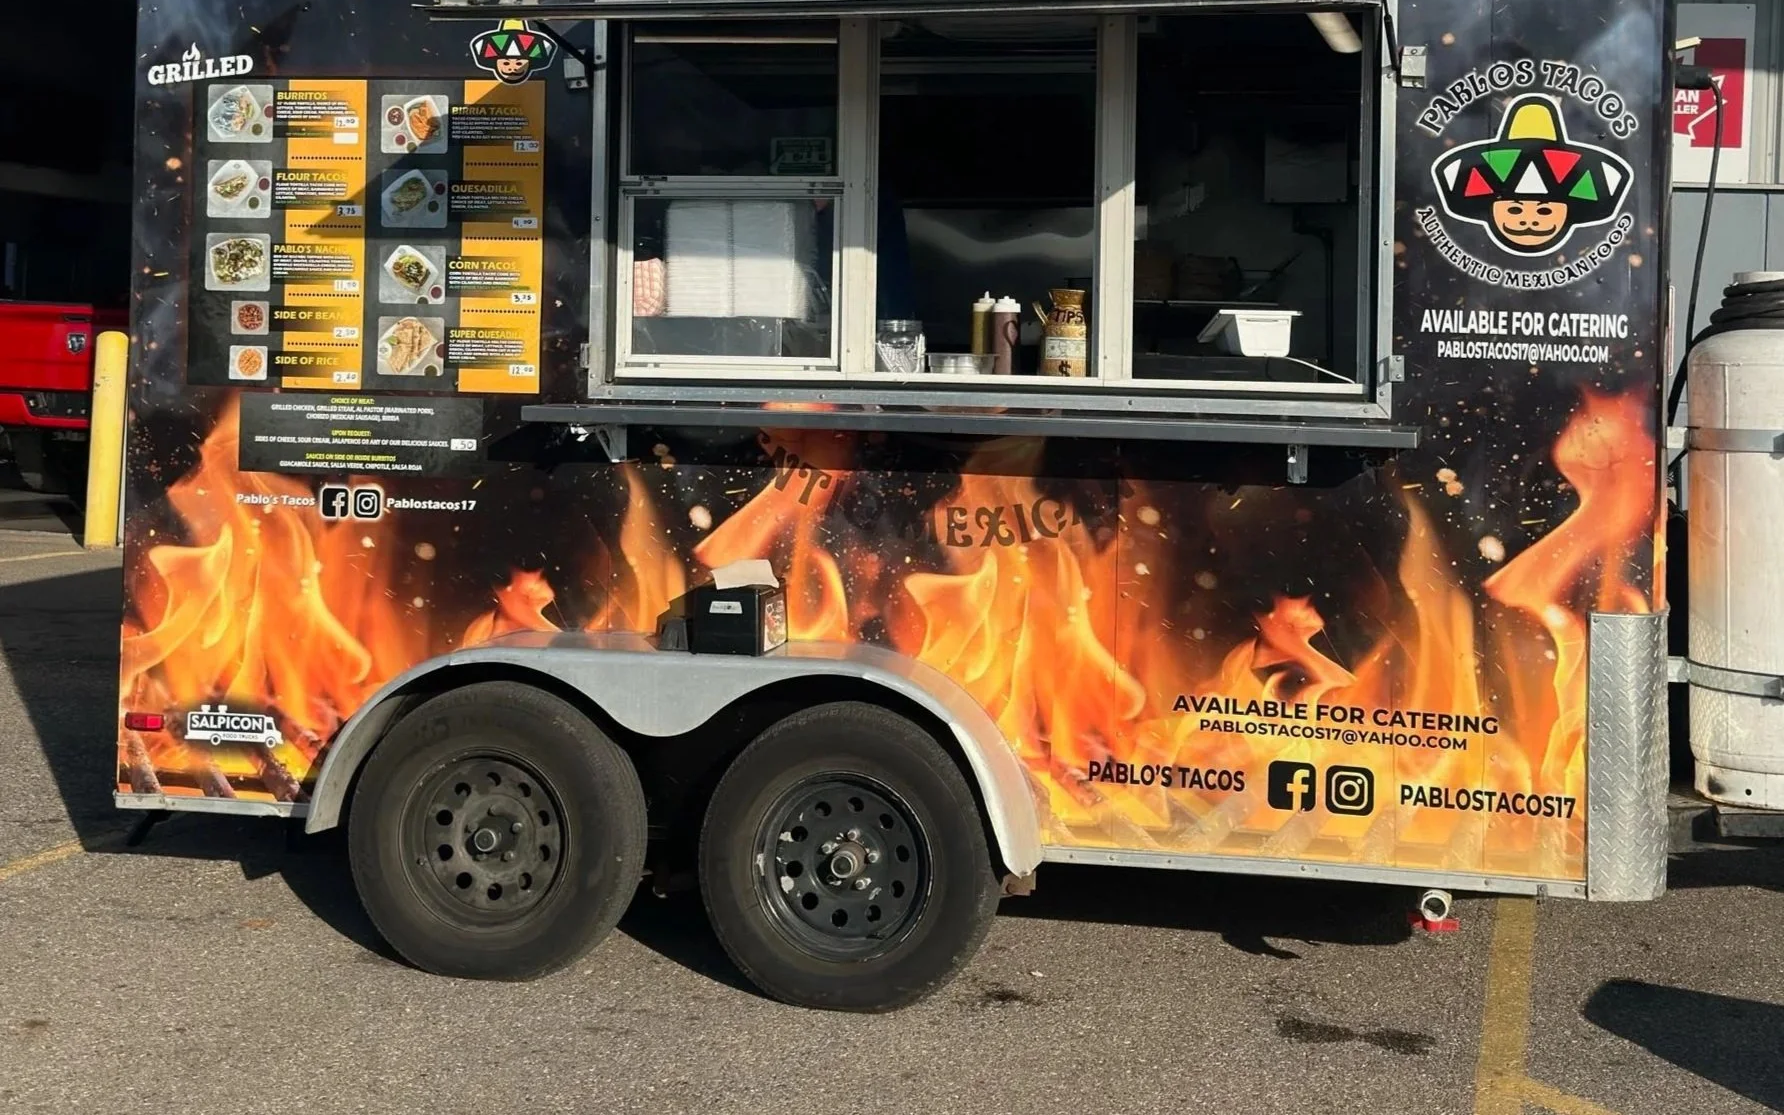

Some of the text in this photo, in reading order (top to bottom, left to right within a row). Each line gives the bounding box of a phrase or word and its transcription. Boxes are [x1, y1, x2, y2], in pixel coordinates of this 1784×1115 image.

[147, 55, 254, 85] GRILLED
[276, 92, 328, 101] BURRITOS
[1417, 59, 1639, 140] PABLOS TACOS
[452, 106, 488, 115] BIRRIA
[276, 172, 348, 182] FLOUR TACOS
[451, 184, 518, 194] QUESADILLA
[273, 244, 312, 254] PABLO'S
[1416, 205, 1502, 284] AUTHENTIC
[1503, 258, 1591, 289] MEXICAN
[448, 260, 517, 270] CORN TACOS
[274, 310, 297, 320] SIDE
[298, 311, 314, 320] OF
[1055, 309, 1083, 324] TIPS
[1420, 309, 1629, 339] AVAILABLE FOR CATERING
[449, 330, 477, 339] SUPER
[1437, 340, 1609, 365] PABLOSTACOS17@YAHOO.COM
[275, 356, 339, 366] SIDE OF RICE
[236, 493, 316, 506] Pablo's Tacos
[387, 498, 477, 511] Pablostacos17
[1172, 695, 1499, 735] AVAILABLE FOR CATERING
[191, 714, 263, 731] SALPICON
[1199, 719, 1468, 751] PABLOSTACOS17@YAHOO.COM
[1088, 760, 1246, 792] PABLO'S TACOS
[1400, 784, 1577, 820] PABLOSTACOS17
